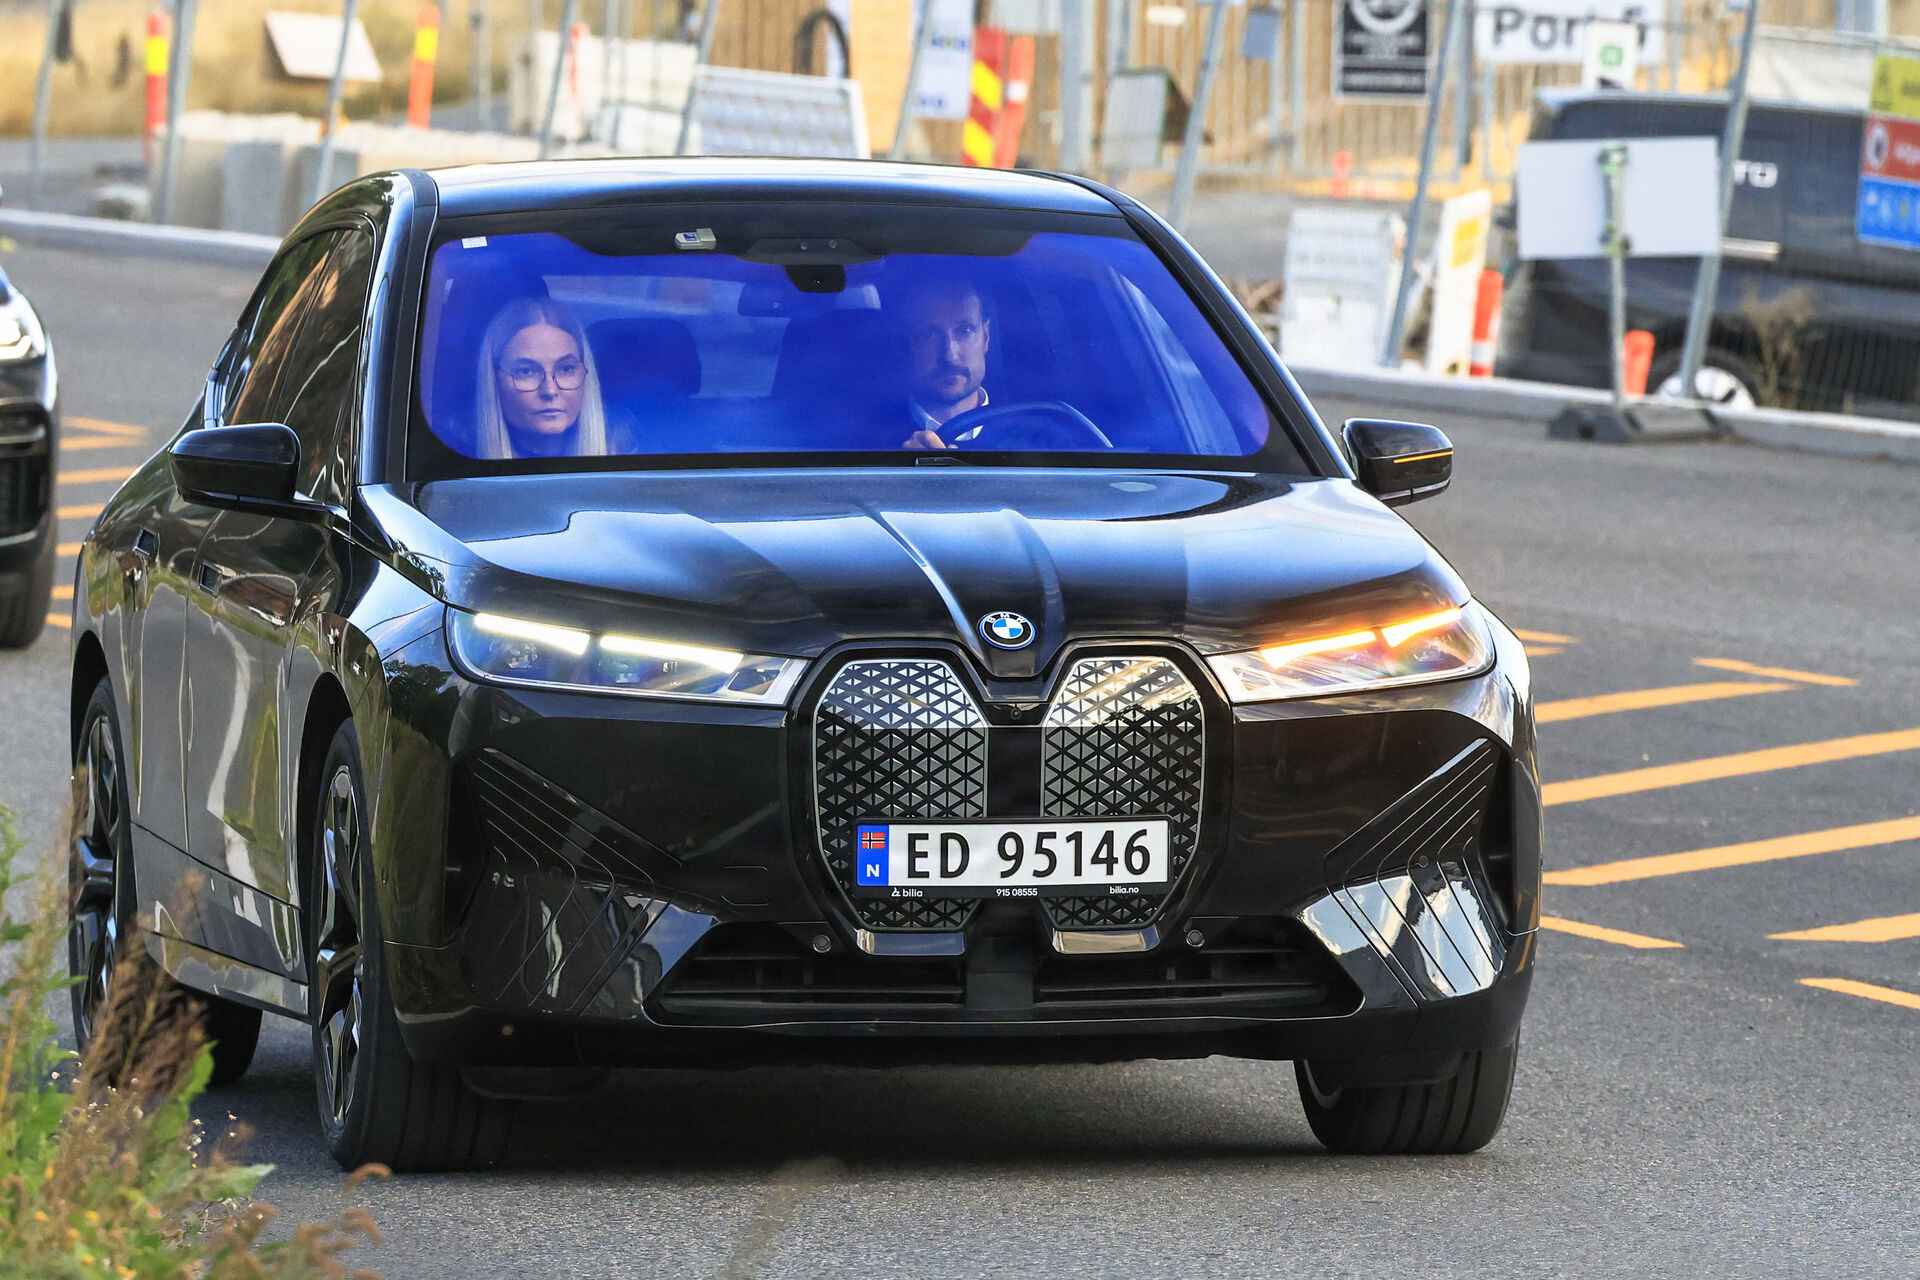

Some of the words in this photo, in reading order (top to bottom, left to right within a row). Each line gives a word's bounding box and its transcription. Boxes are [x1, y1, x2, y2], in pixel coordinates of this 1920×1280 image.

[986, 612, 1027, 624] BMW
[907, 832, 970, 878] ED
[997, 829, 1150, 878] 95146
[866, 864, 880, 877] N
[902, 888, 923, 897] bilia
[996, 888, 1010, 897] 915
[1011, 887, 1038, 897] 08555
[1109, 885, 1140, 894] bilia.no
